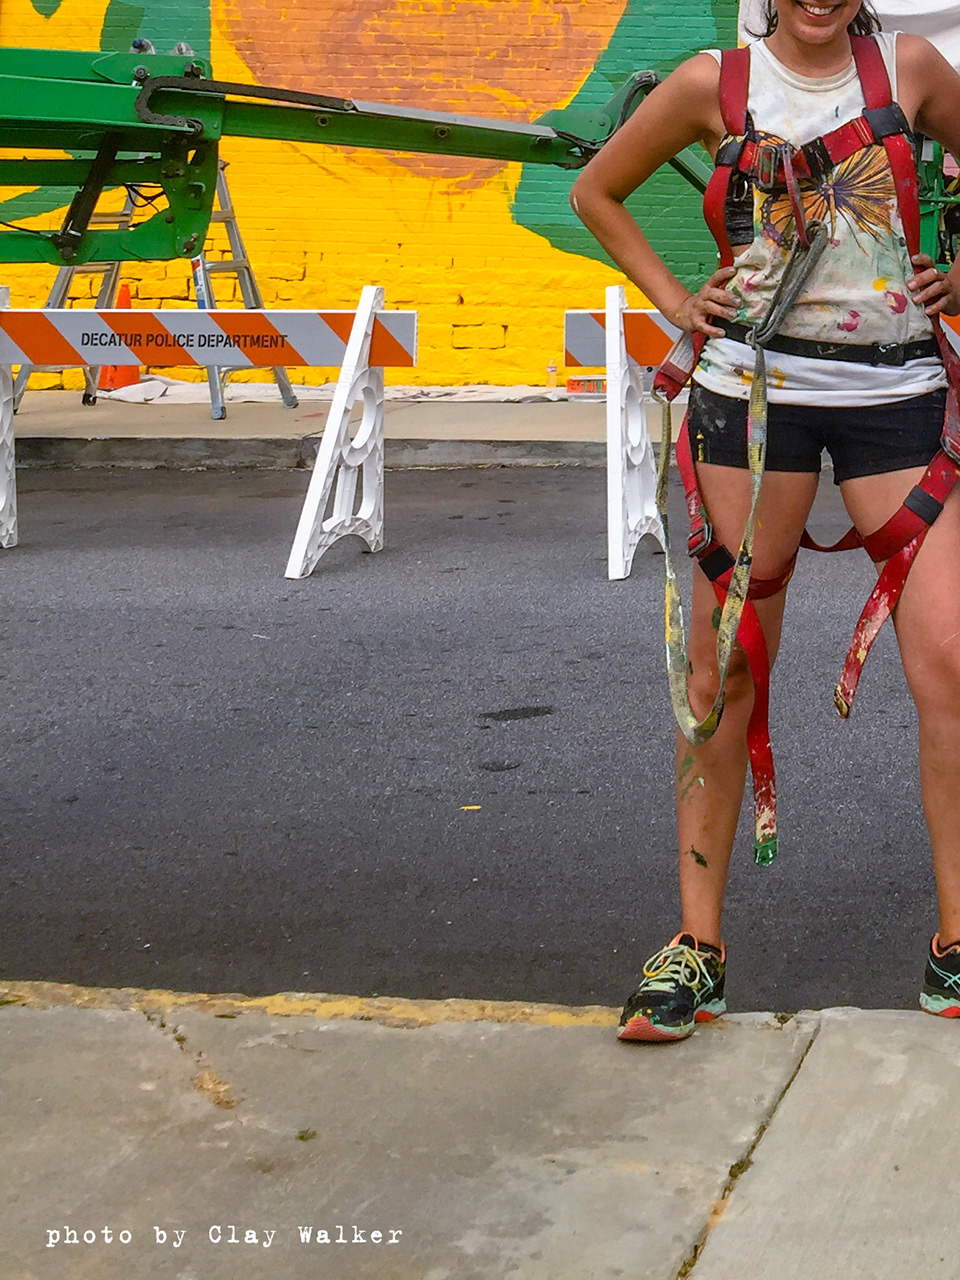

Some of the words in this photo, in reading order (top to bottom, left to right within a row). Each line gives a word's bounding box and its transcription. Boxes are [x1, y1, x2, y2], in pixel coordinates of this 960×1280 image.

[81, 332, 143, 347] DECATUR
[145, 333, 195, 349] POLICE
[197, 333, 288, 349] DEPARTMENT
